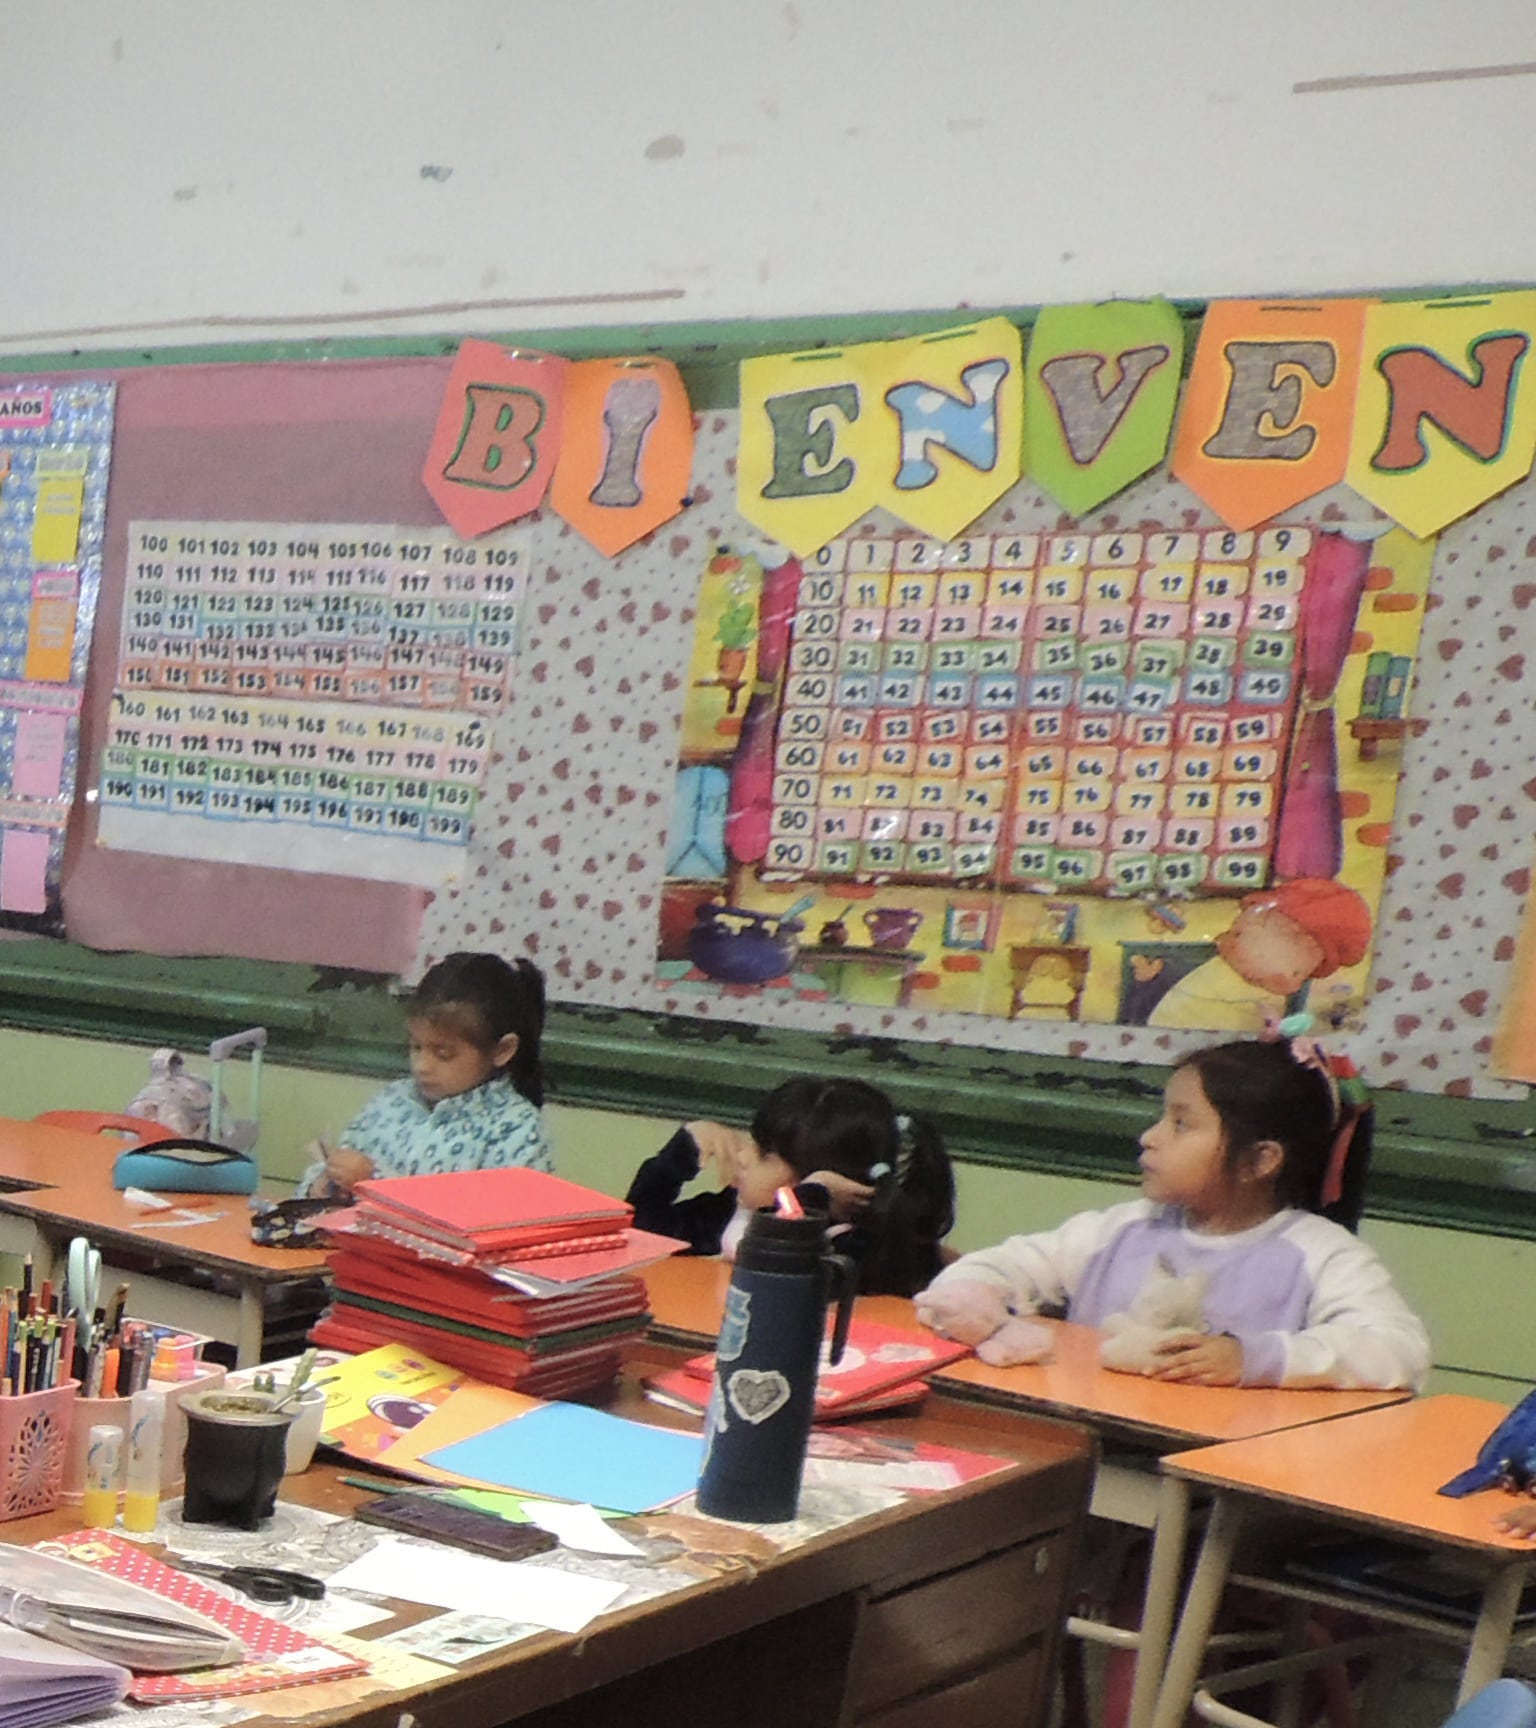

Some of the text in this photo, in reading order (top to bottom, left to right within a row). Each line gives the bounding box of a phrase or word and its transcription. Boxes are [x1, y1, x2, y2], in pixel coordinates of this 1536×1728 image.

[442, 331, 1531, 507] BIENVEN
[140, 534, 518, 566] 100 101 102 103 104 106 107 109
[816, 545, 831, 565] 0
[867, 543, 875, 564] 1
[911, 542, 925, 564] 2
[958, 540, 972, 563] 3
[1004, 540, 1022, 560] 4
[1107, 537, 1124, 560] 6
[1165, 534, 1180, 556] 7
[1220, 530, 1237, 555] 8
[1275, 529, 1291, 552] 9
[137, 563, 514, 592] 110 111 112 113 117 119
[811, 576, 1228, 603] 10 11 12 13 14 15 16 17 18
[134, 589, 514, 622] 120 121 123 127 129
[169, 613, 511, 647] 131 139
[804, 612, 1231, 635] 20 21 22 23 24 25 26 27 28
[163, 641, 503, 674] 141 142 143 147 149
[801, 646, 831, 668] 30
[892, 649, 915, 666] 32
[939, 650, 964, 667] 33
[983, 650, 1008, 668] 34
[1090, 653, 1118, 671] 36
[1253, 639, 1283, 658] 39
[388, 674, 420, 692] 157
[797, 679, 1220, 701] 40 41 42 44 45 48
[221, 709, 407, 737] 163 167
[790, 714, 1265, 743] 50 54 56 57 59
[146, 732, 478, 775] 171 173 174 175 177 179
[785, 746, 1261, 778] 60 62 64 66 67 69
[140, 783, 205, 805] 191 192
[141, 757, 469, 805] 181 187 189
[783, 778, 811, 799] 70
[832, 785, 852, 799] 71
[875, 784, 897, 800] 72
[965, 789, 988, 806] 74
[1074, 787, 1098, 803] 76
[1236, 791, 1262, 807] 79
[778, 809, 1199, 846] 80 86 88
[774, 843, 1257, 878] 90 96 99
